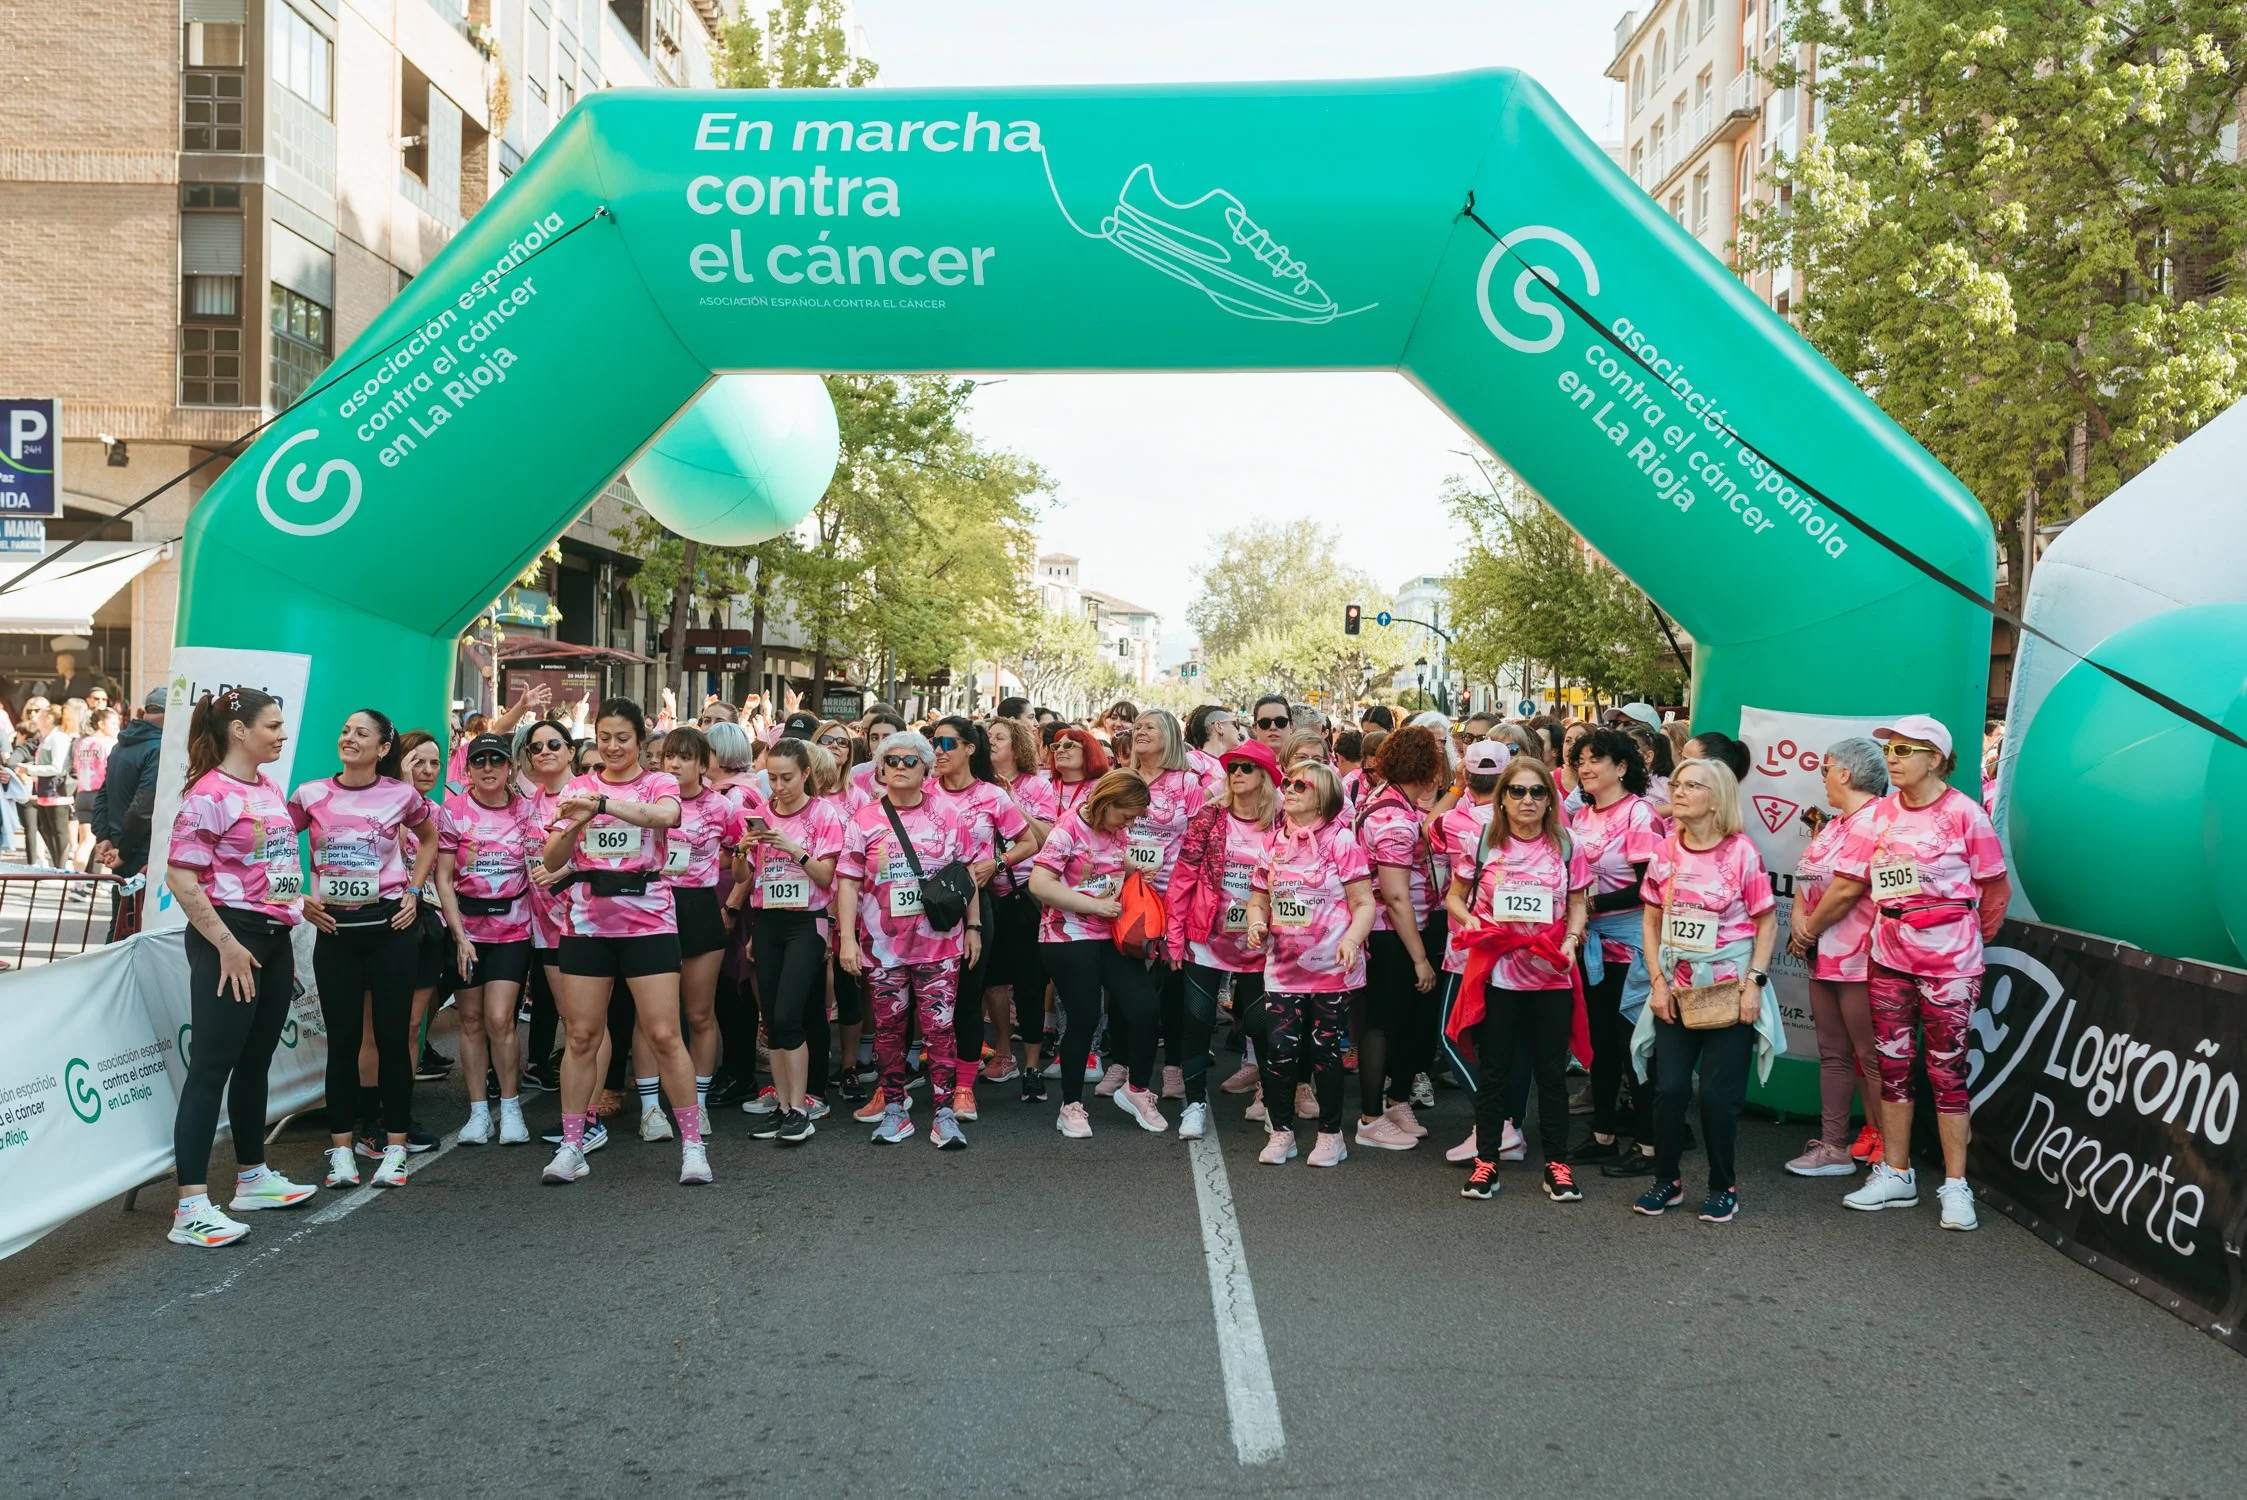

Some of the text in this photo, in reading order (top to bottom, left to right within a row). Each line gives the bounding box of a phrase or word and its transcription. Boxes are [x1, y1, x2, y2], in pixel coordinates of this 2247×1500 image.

[694, 111, 1042, 153] En marcha
[686, 165, 901, 217] contra
[689, 228, 996, 286] el cáncer
[699, 295, 946, 310] ASOCIACIÓN ESPAÑOLA CONTRA EL CÁNCER
[339, 211, 565, 419] asociación española
[357, 276, 539, 442] contra el cáncer
[378, 346, 519, 468] en La Rioja
[10, 410, 48, 460] P
[1557, 369, 1697, 513] en La Rioja
[1585, 344, 1776, 535] contra el cáncer
[1611, 316, 1849, 559] asociación española
[823, 697, 857, 706] ARRIGAS
[824, 706, 857, 714] RVECERAS
[1766, 739, 1829, 772] LOG
[598, 831, 628, 848] 869
[328, 851, 349, 860] por la
[476, 849, 508, 857] Carrera
[764, 855, 790, 863] Carrera
[476, 859, 491, 868] por
[764, 866, 776, 874] por
[889, 862, 905, 871] por
[274, 876, 300, 894] 3962
[1223, 870, 1247, 880] por la
[1272, 879, 1303, 887] Carrera
[1879, 867, 1913, 889] 5505
[328, 880, 370, 897] 3963
[769, 883, 800, 899] 1031
[1504, 895, 1542, 912] 1252
[1671, 899, 1703, 910] Carrera
[1671, 920, 1706, 940] 1237
[303, 1029, 312, 1038] en
[97, 1037, 173, 1073] asociación española
[102, 1059, 167, 1091] contra el cáncer
[2042, 998, 2240, 1145] Logroño
[16, 1074, 57, 1100] española
[107, 1083, 153, 1111] en La Rioja
[5, 1107, 16, 1124] el
[15, 1100, 45, 1121] cáncer
[5, 1127, 29, 1147] Rioja
[2010, 1092, 2206, 1257] Deporte
